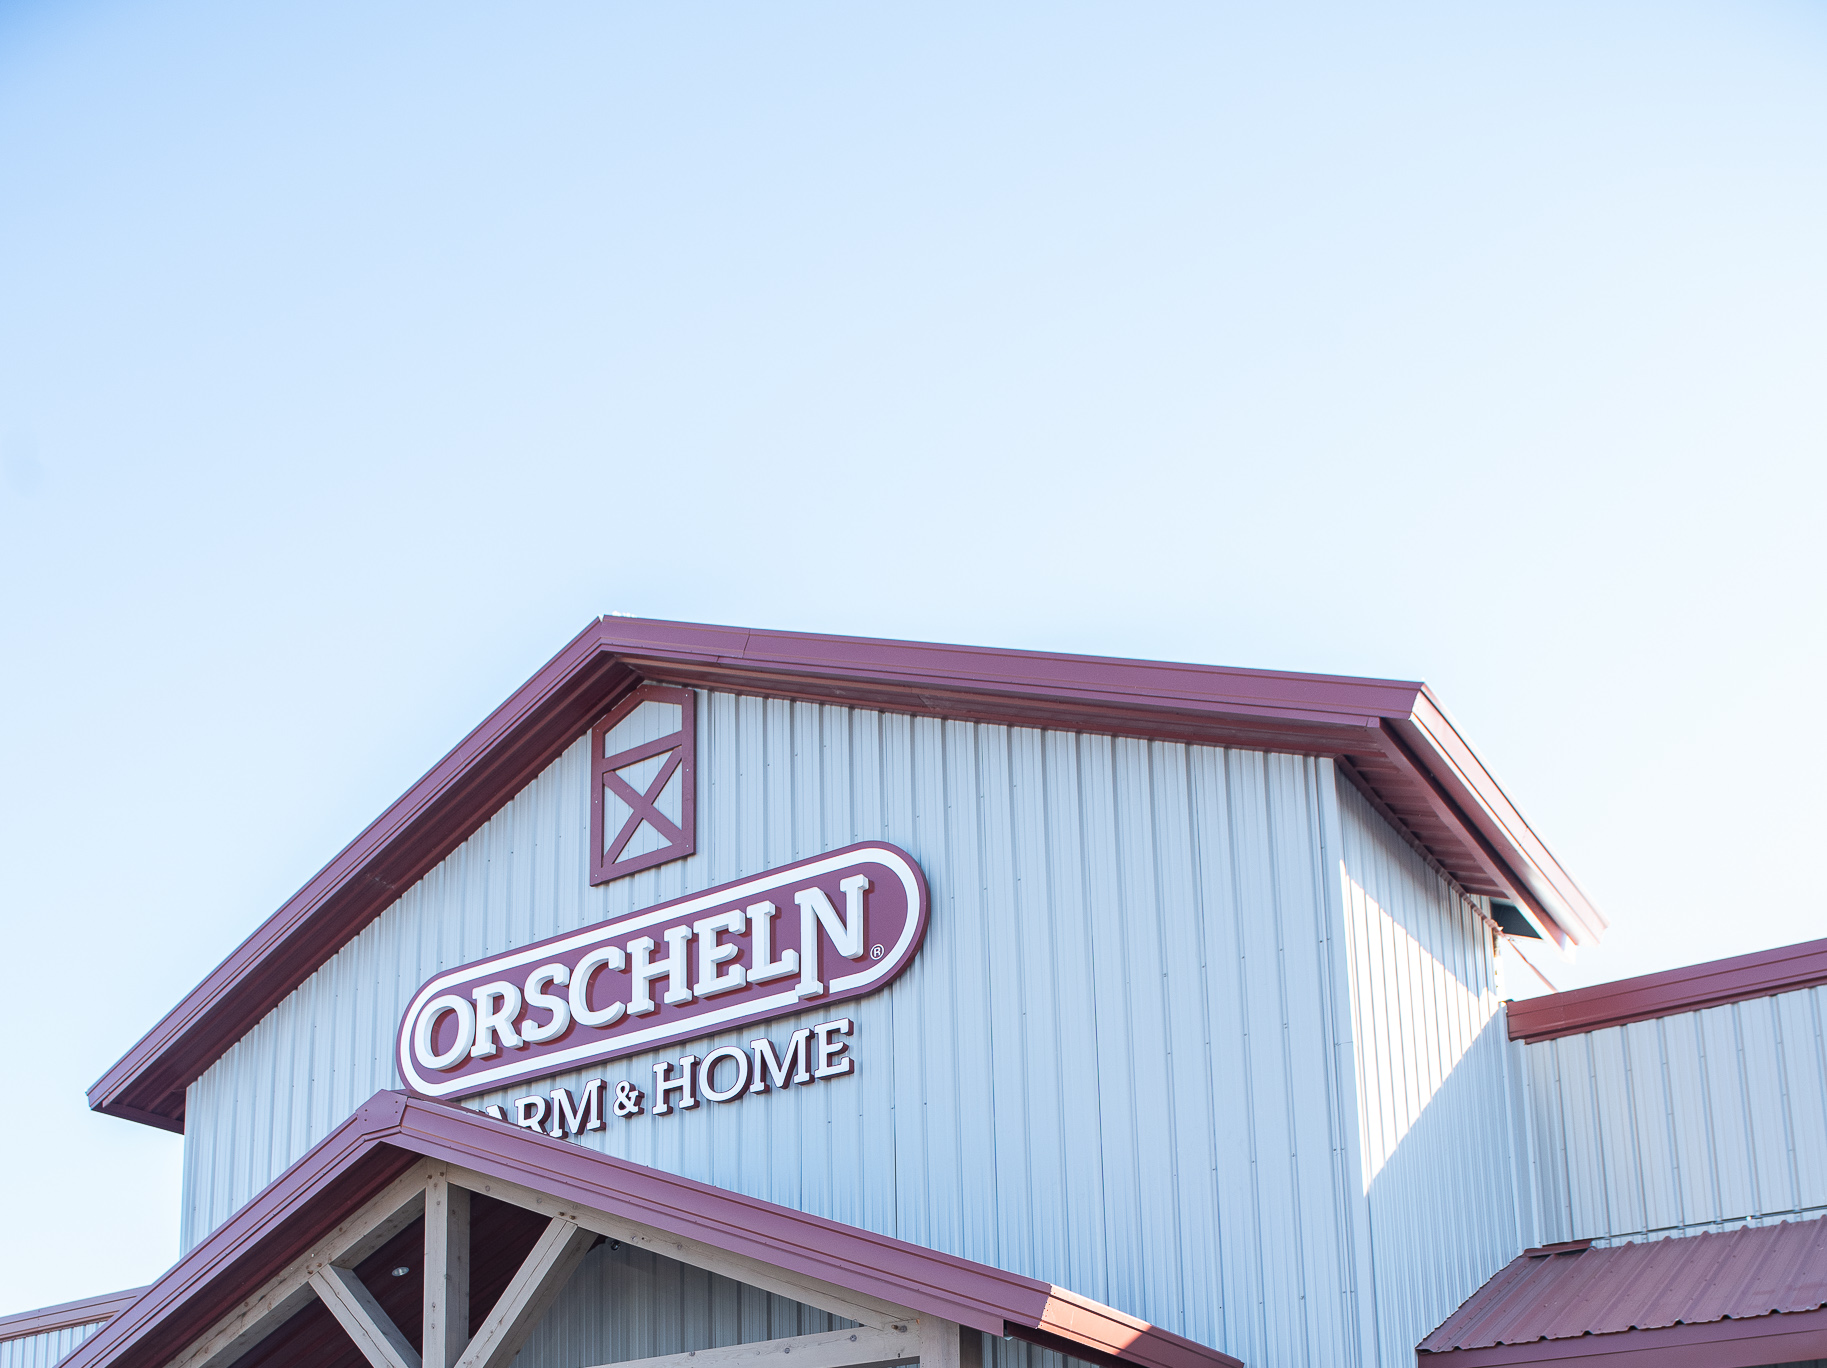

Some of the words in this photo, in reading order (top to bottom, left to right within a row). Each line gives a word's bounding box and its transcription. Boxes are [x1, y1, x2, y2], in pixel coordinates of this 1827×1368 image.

[414, 874, 870, 1069] ORSCHELN
[476, 1078, 607, 1139] RM
[613, 1081, 645, 1118] &
[652, 1018, 855, 1116] HOME
